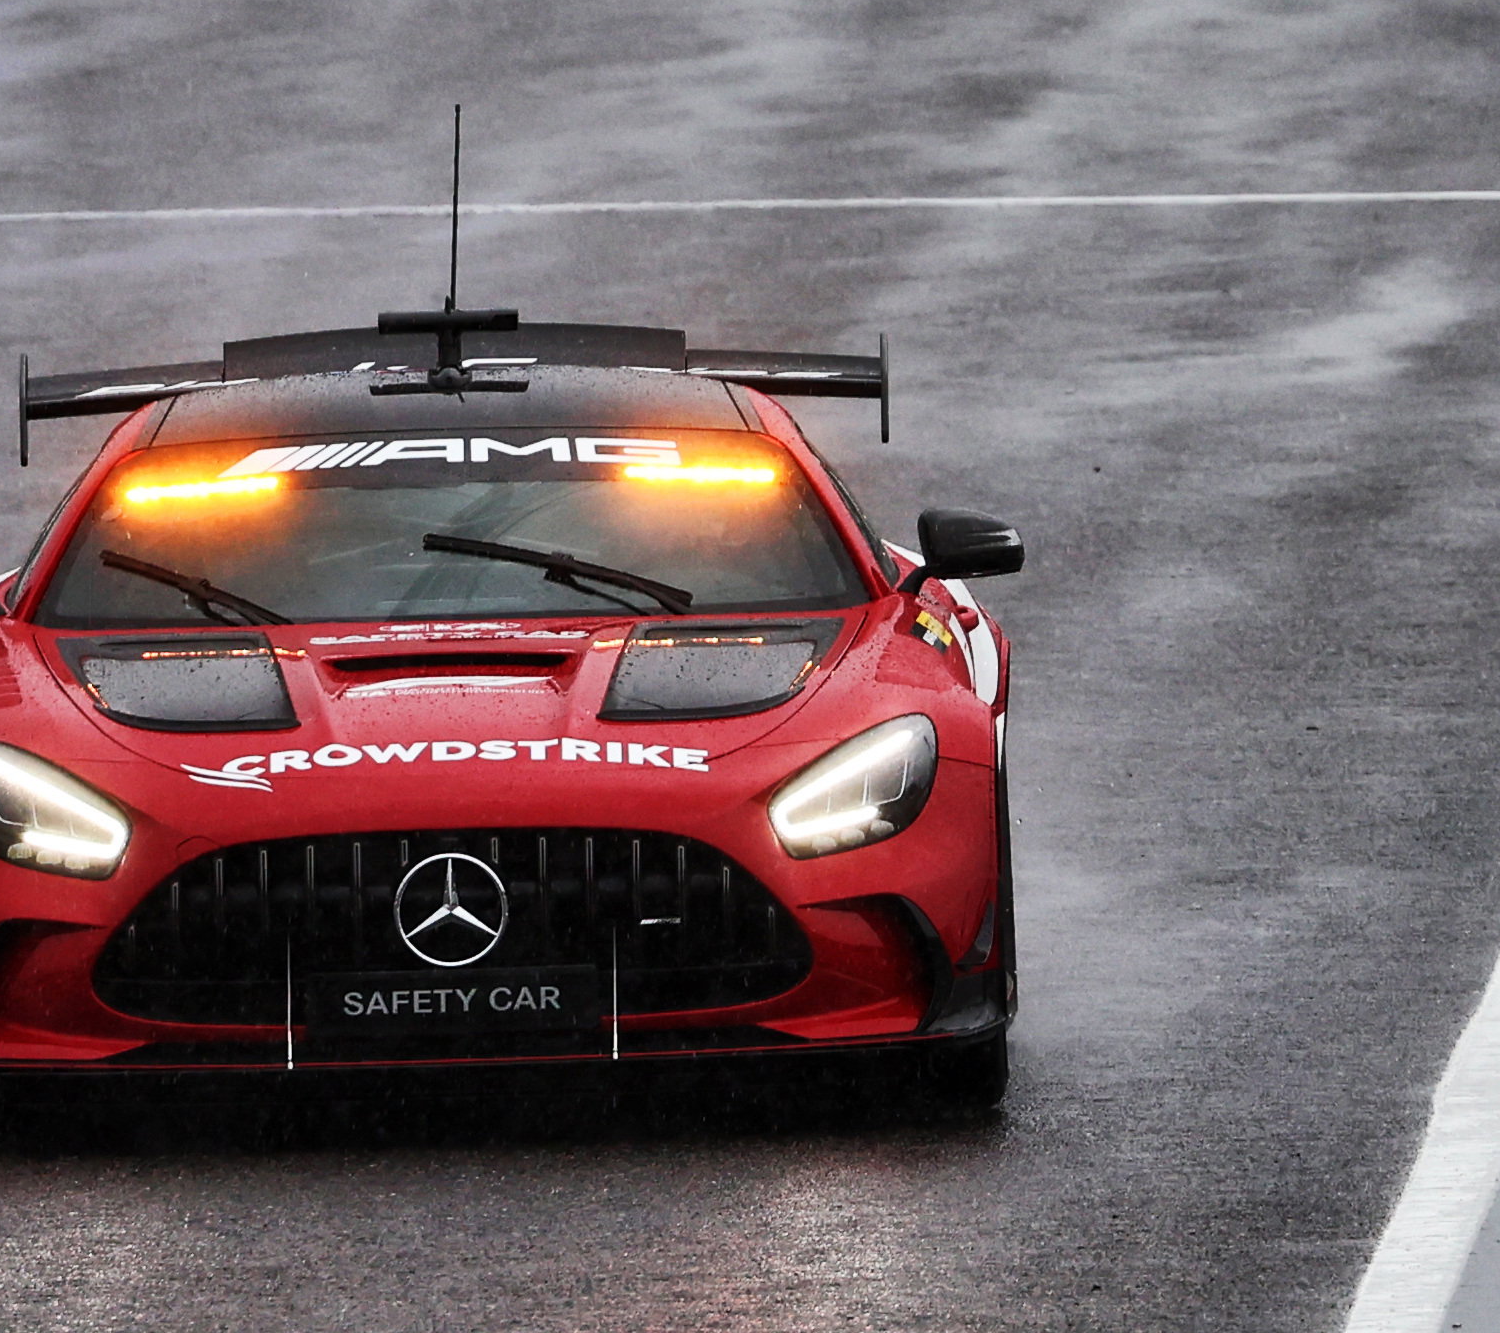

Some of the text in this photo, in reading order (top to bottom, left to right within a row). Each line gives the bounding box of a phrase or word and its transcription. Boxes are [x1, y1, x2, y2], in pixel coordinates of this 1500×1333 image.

[222, 737, 710, 778] CROWDSTRIKE
[343, 986, 561, 1016] SAFETY CAR
